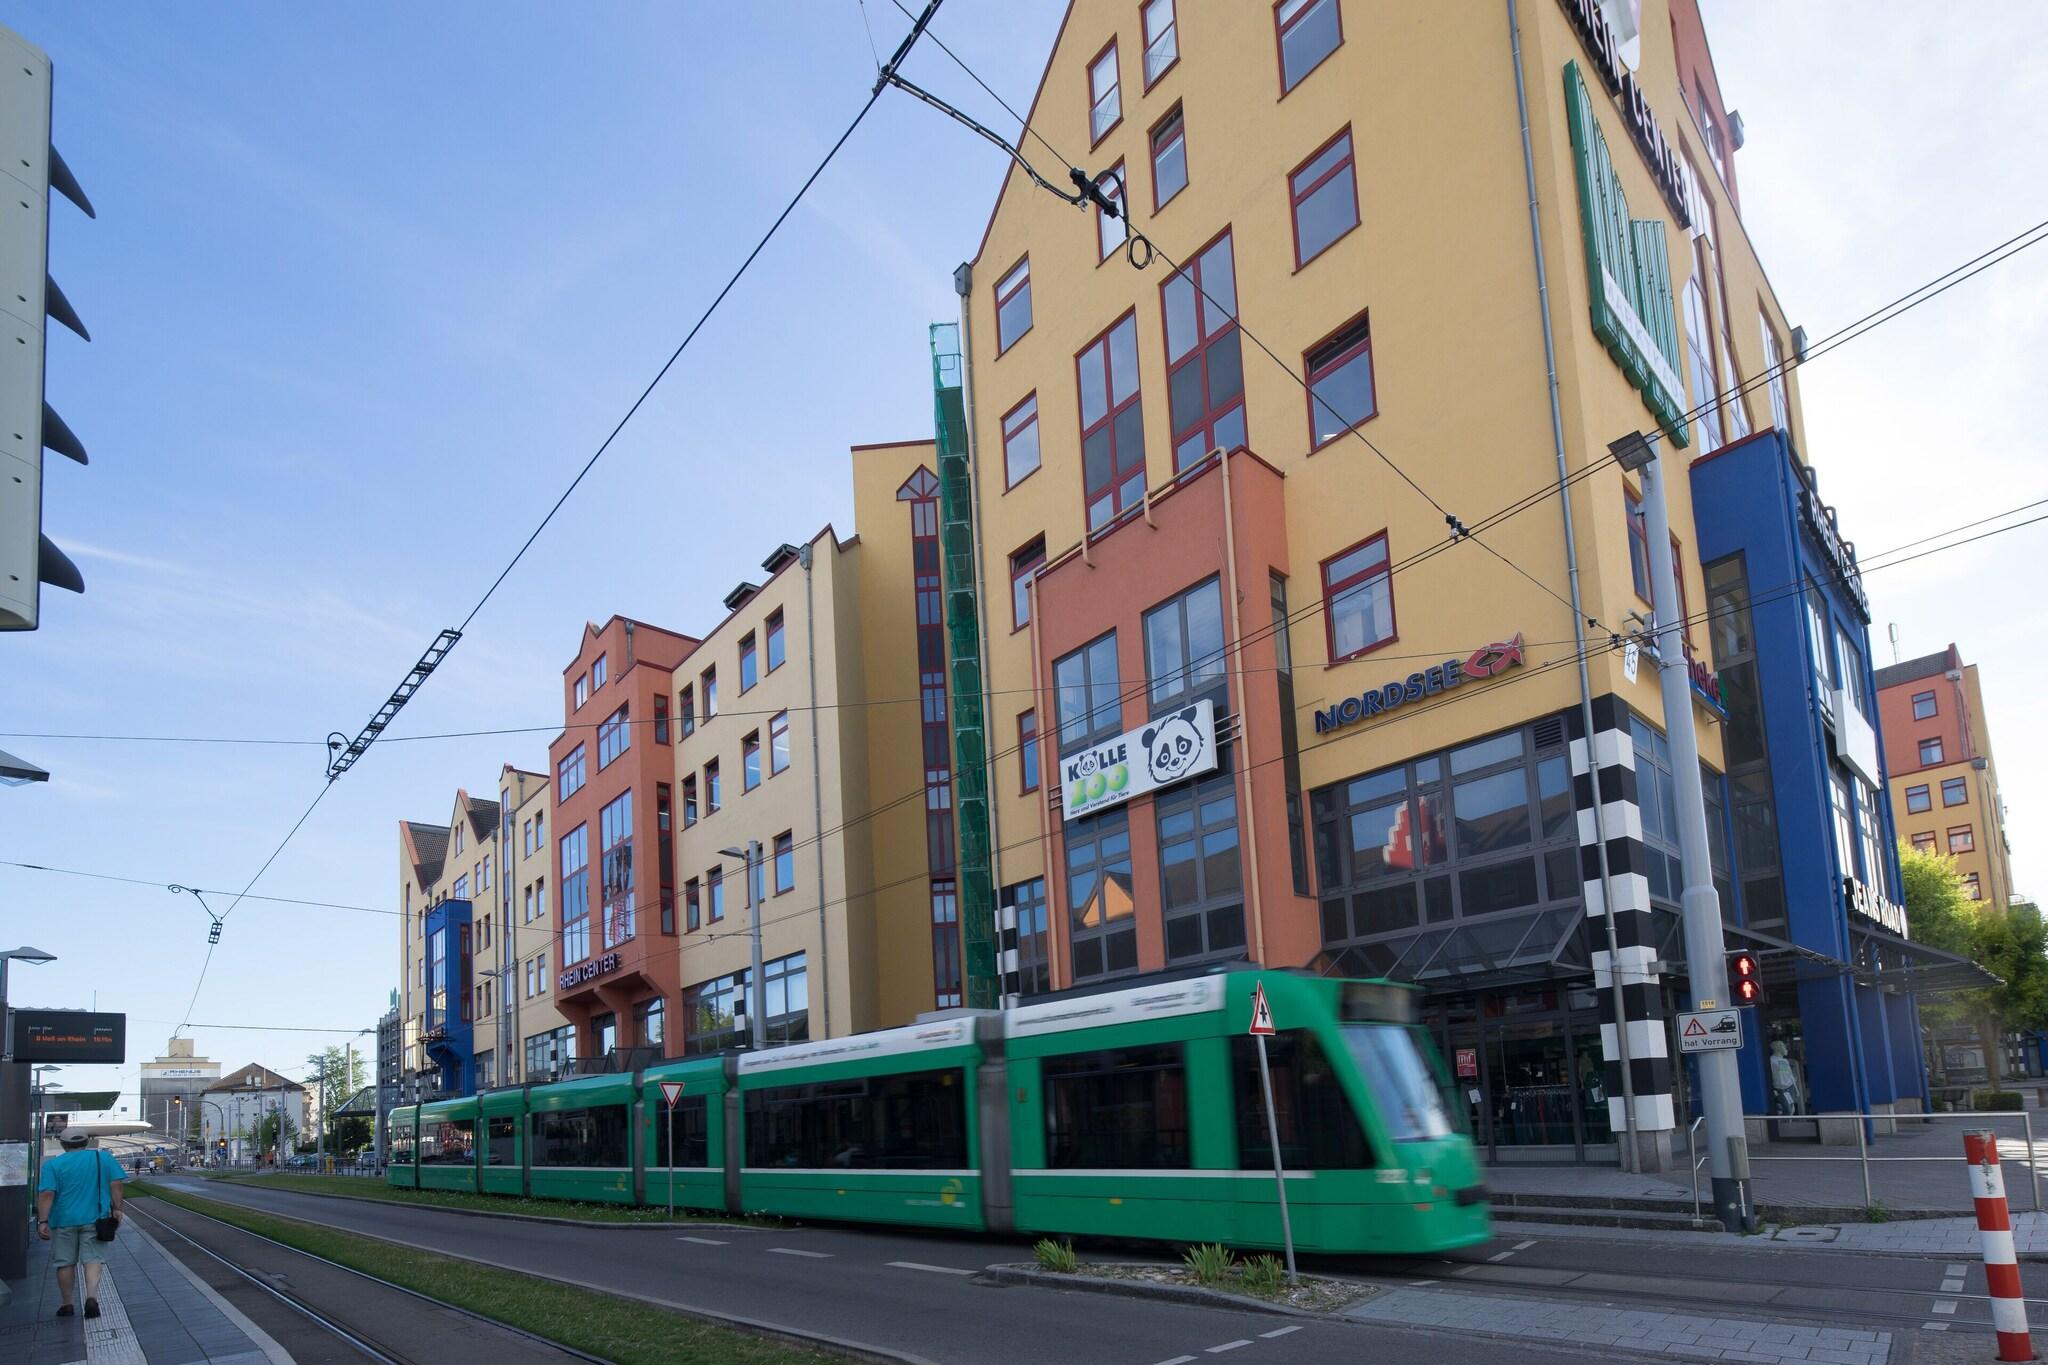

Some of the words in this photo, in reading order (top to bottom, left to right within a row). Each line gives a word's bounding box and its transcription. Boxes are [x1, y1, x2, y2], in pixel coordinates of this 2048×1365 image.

[1808, 487, 1842, 567] RHEIN
[1314, 658, 1461, 735] NORDSEE
[1070, 763, 1130, 809] ZOO
[559, 967, 582, 990] RHEIN
[582, 952, 616, 980] CENTER
[1684, 1039, 1698, 1047] hat
[1702, 1038, 1738, 1046] Vorrang
